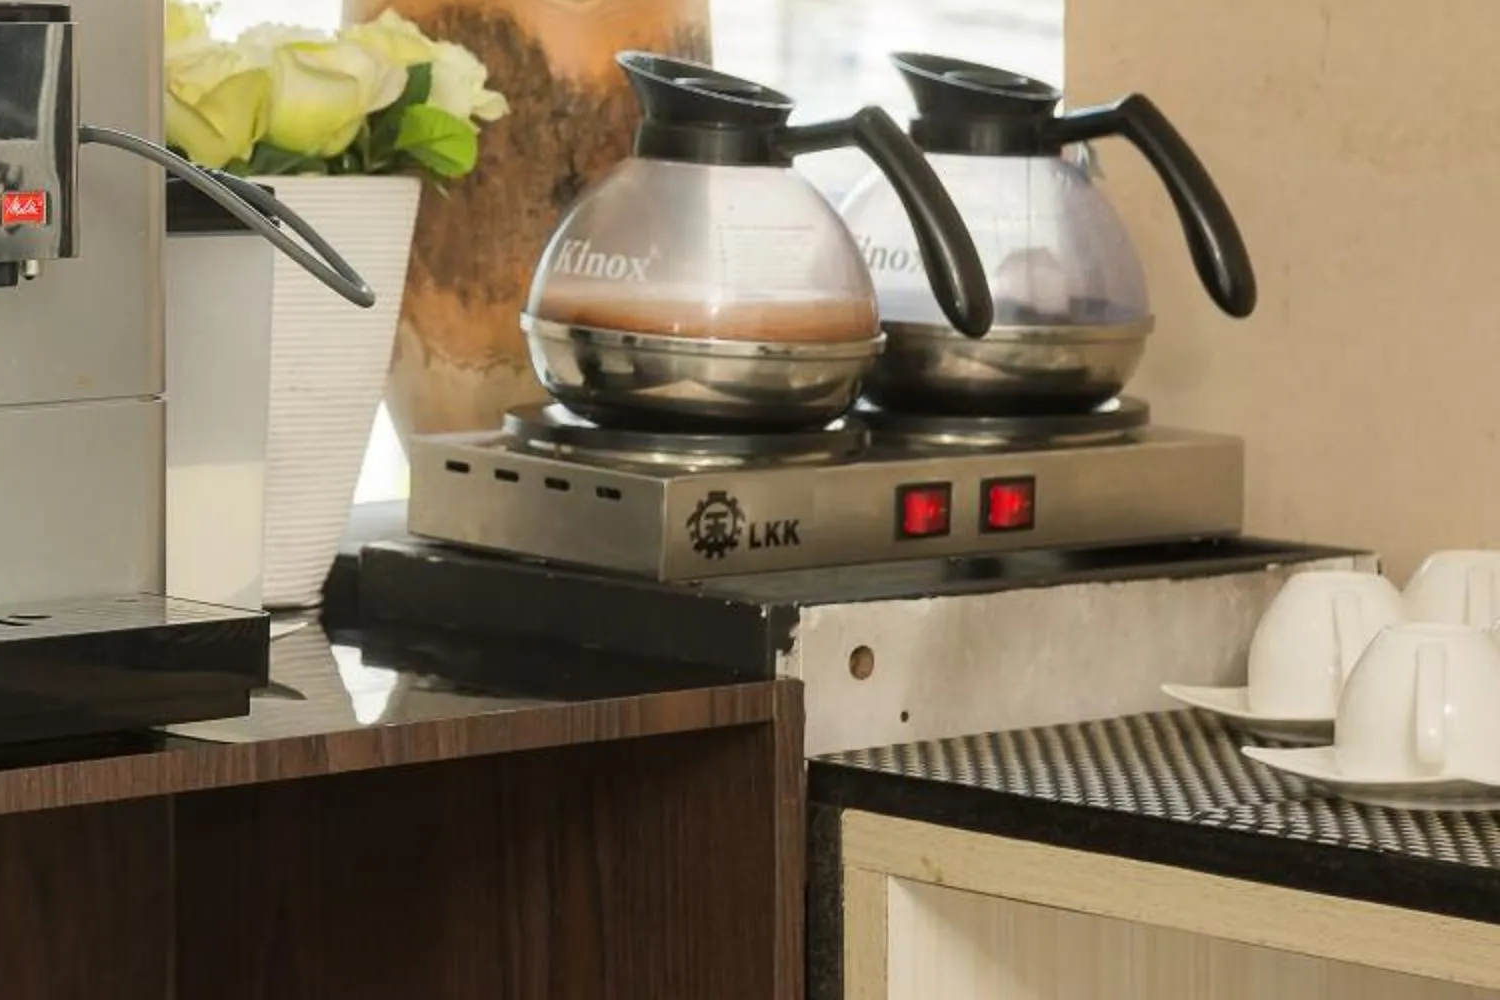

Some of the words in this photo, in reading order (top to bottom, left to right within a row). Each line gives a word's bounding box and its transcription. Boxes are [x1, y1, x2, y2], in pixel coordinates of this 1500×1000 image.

[553, 238, 652, 283] Kinox
[855, 234, 920, 274] ino
[748, 519, 801, 550] LKK
